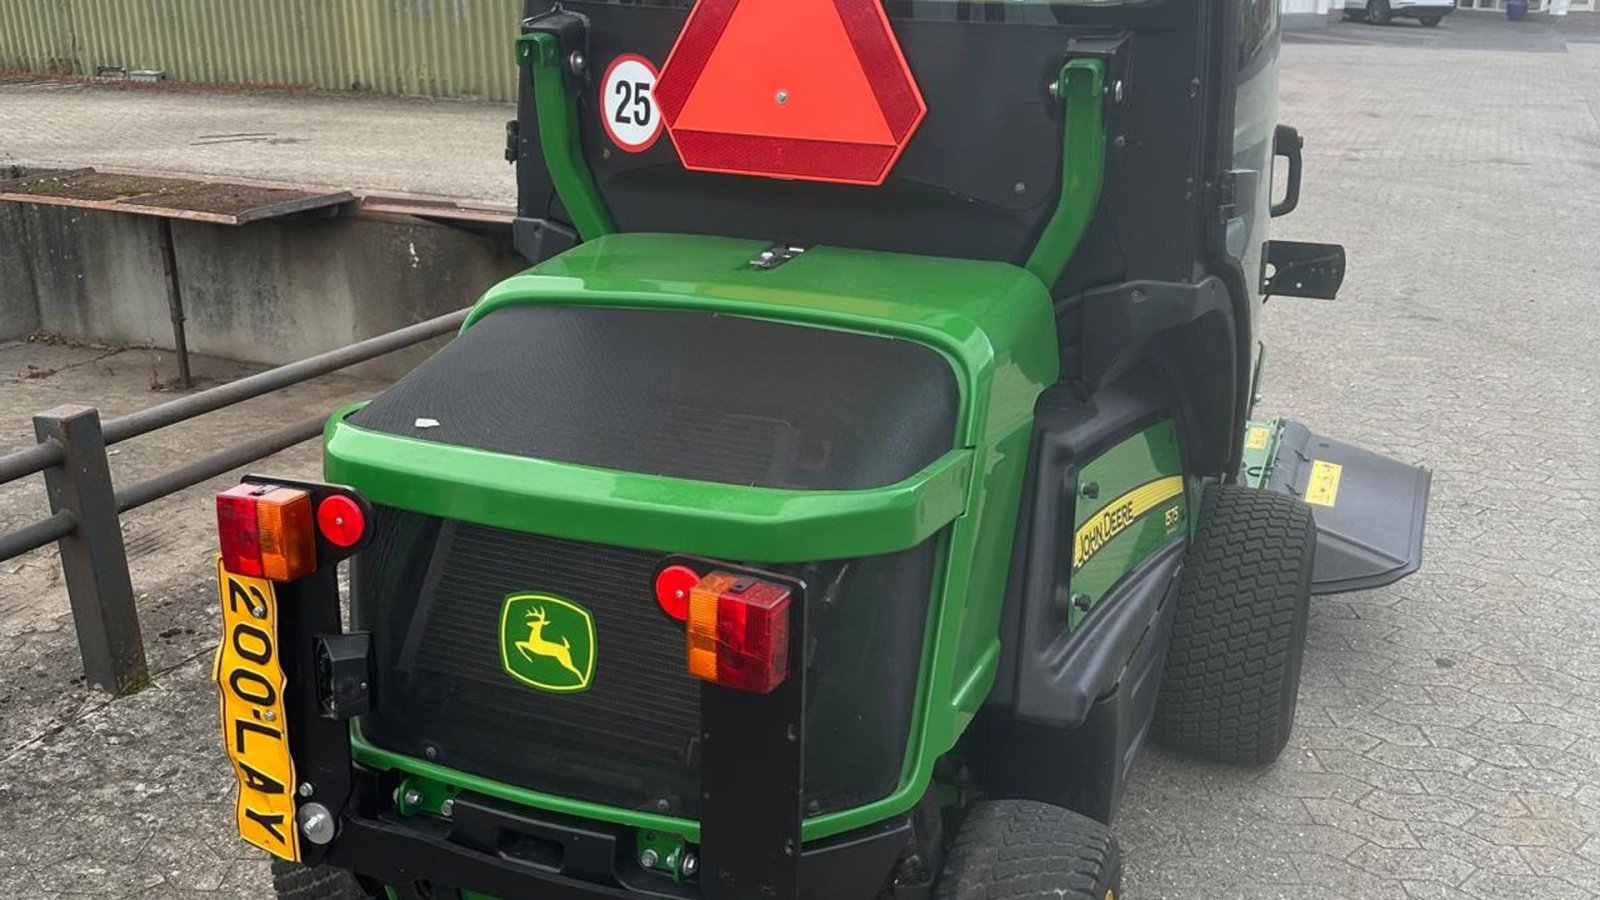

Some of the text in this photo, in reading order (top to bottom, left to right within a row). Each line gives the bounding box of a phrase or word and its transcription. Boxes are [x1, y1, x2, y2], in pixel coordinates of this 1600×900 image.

[614, 79, 651, 126] 25
[1078, 500, 1134, 563] JOHN DEERE
